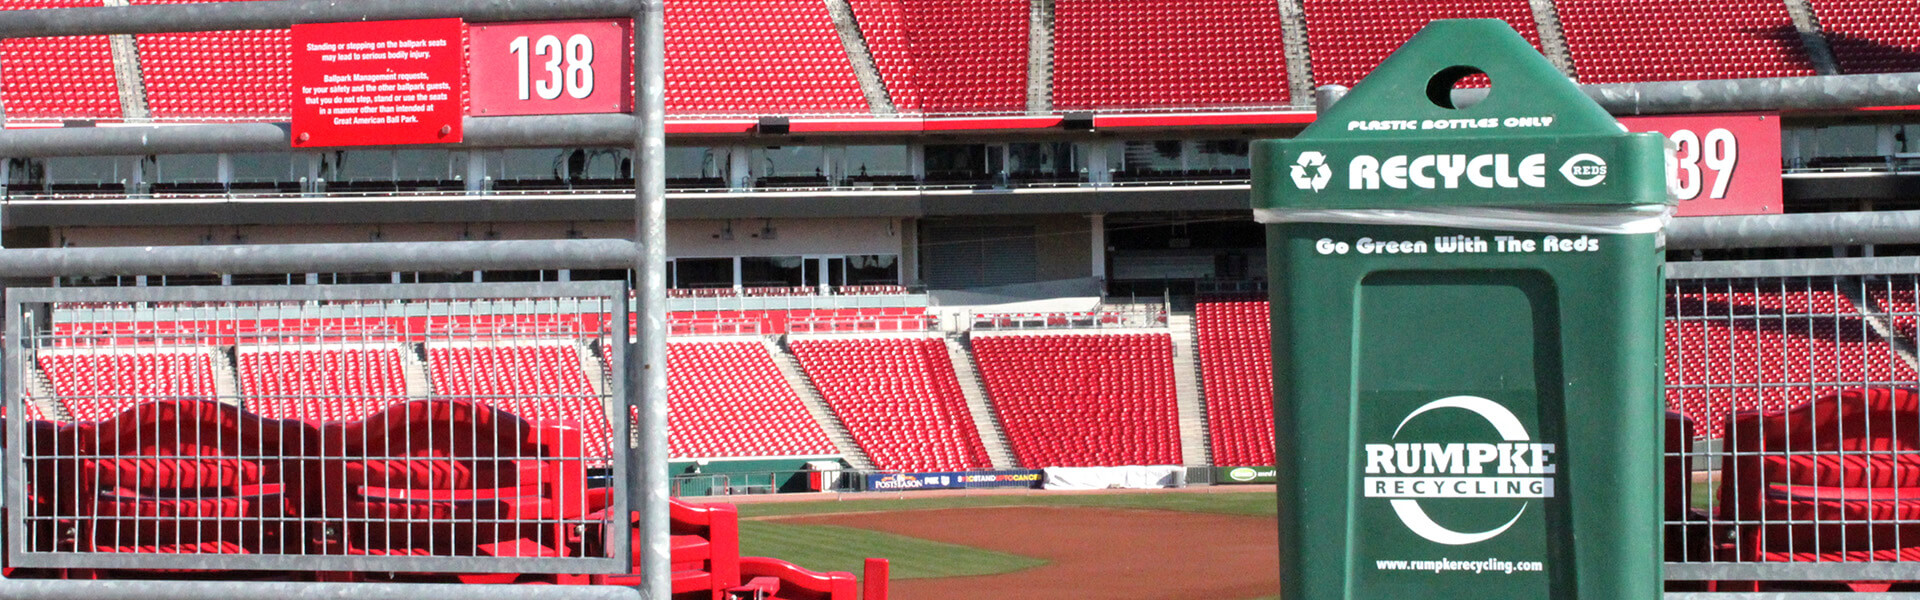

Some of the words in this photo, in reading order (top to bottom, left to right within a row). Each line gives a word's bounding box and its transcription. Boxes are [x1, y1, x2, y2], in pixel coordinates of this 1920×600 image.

[306, 43, 336, 51] Standing
[346, 42, 375, 51] stepping
[386, 40, 398, 48] the
[399, 40, 427, 48] ballpark
[428, 39, 447, 47] seats
[362, 52, 386, 60] serious
[388, 50, 408, 60] bodily
[409, 50, 431, 59] injury.
[510, 33, 594, 100] 138
[324, 74, 352, 83] Ballpark
[353, 73, 396, 82] Management
[398, 72, 429, 81] requests,
[302, 86, 312, 94] for
[313, 87, 328, 95] your
[330, 85, 350, 94] safety
[352, 84, 364, 92] and
[366, 84, 377, 92] the
[378, 83, 396, 91] other
[397, 82, 425, 92] ballpark
[426, 82, 451, 91] guests,
[356, 95, 373, 104] step,
[374, 94, 393, 102] stand
[417, 93, 428, 101] the
[360, 106, 377, 114] other
[396, 104, 425, 112] intended
[334, 117, 352, 125] Great
[353, 116, 385, 124] American
[1348, 120, 1417, 131] PLASTIC
[1422, 118, 1499, 130] BOTTLES
[1503, 116, 1553, 128] ONLY
[1572, 165, 1607, 175] REDS
[1669, 128, 1738, 200] 39
[1349, 153, 1545, 190] RECYCLE
[1316, 237, 1350, 255] Go
[1356, 236, 1428, 254] Green
[1434, 235, 1488, 254] With
[1494, 235, 1537, 253] The
[1543, 235, 1599, 252] Reds
[1365, 443, 1556, 474] RUMPKE
[1375, 480, 1543, 494] RECYCLING
[1376, 558, 1543, 574] www.rumpkerecycling.com
